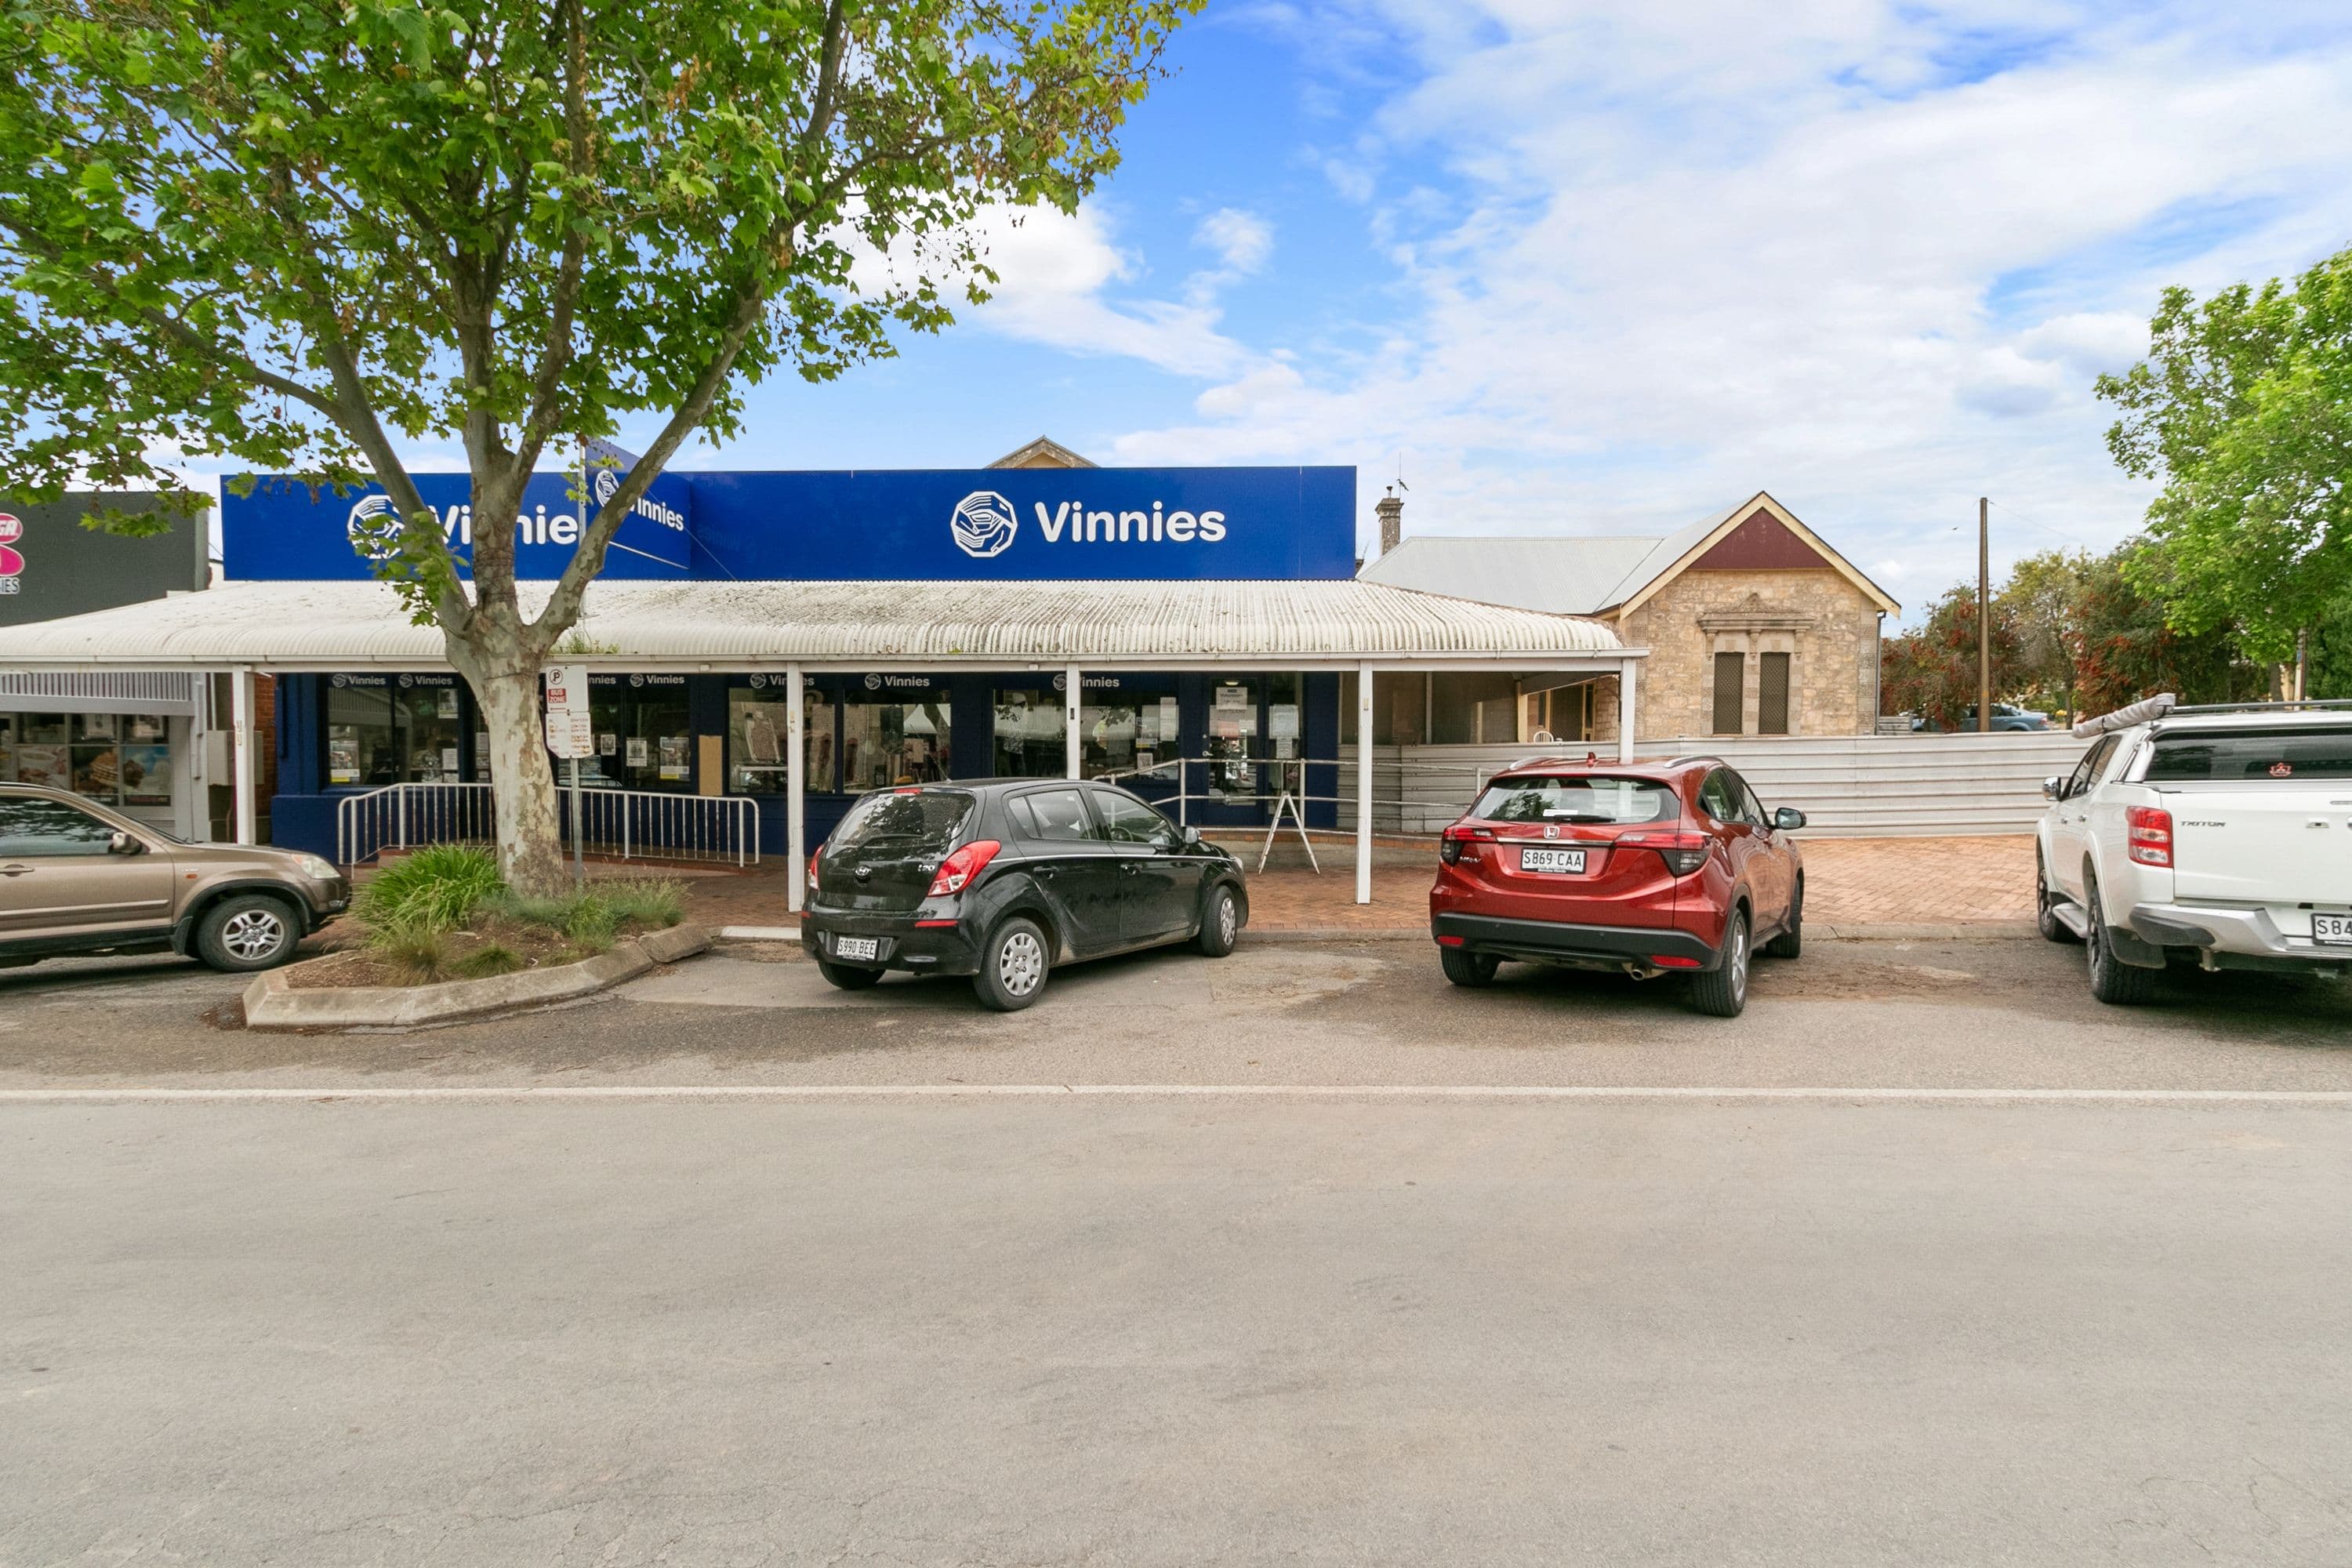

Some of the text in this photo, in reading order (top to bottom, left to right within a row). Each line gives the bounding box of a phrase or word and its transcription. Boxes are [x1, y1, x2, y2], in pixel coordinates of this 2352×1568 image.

[426, 504, 579, 545] Vinie
[1034, 500, 1227, 543] Vinnies
[348, 675, 387, 685] Vinnies
[415, 675, 453, 685] Vinnies
[588, 675, 616, 684] nnies
[646, 675, 685, 684] Vinnies
[884, 676, 931, 687] Vinnies
[1080, 677, 1120, 687] innies
